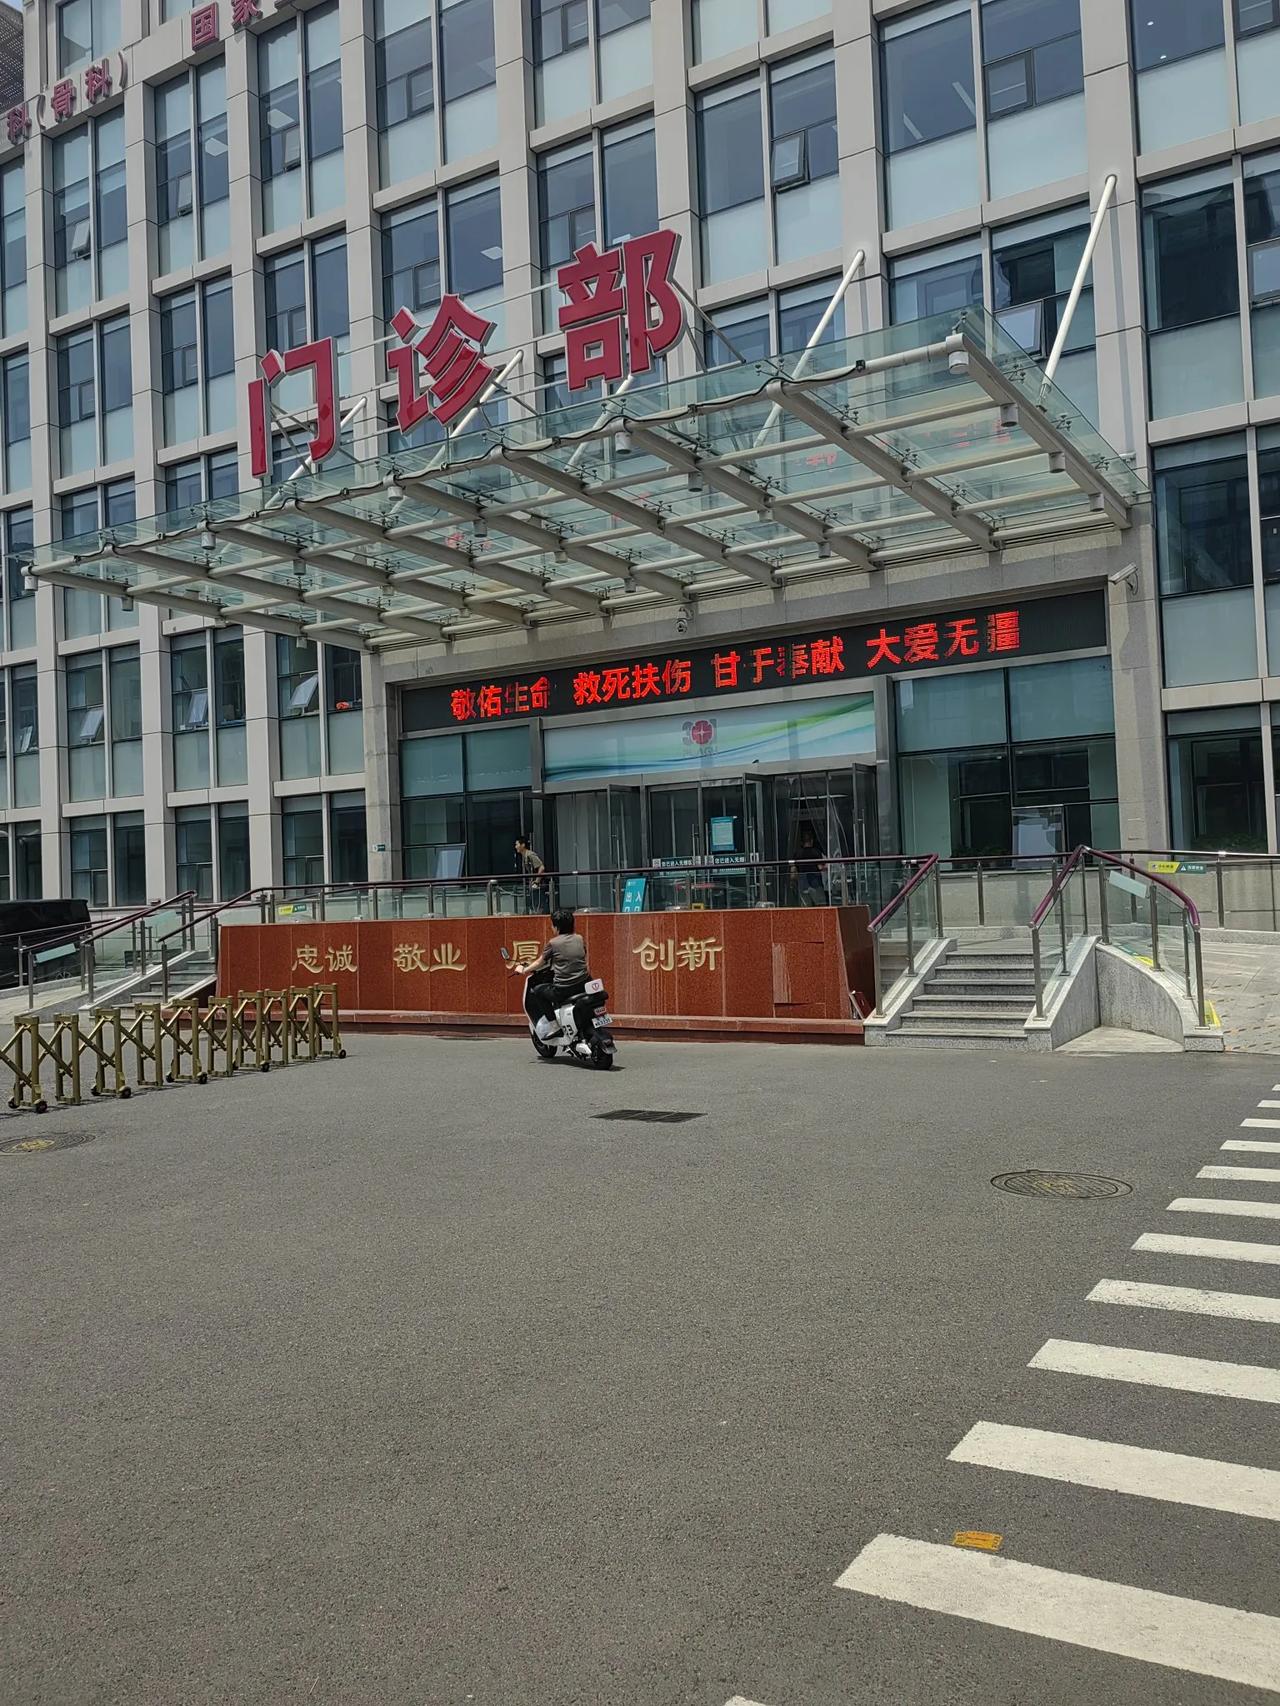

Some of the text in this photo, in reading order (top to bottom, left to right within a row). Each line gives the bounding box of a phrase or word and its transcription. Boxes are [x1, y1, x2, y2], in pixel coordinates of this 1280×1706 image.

[248, 228, 688, 478] 门诊部
[450, 676, 550, 721] 敬佑生命
[572, 659, 692, 706] 救死扶伤
[865, 610, 1020, 670] 大爱无疆
[291, 944, 359, 975] 忠诚
[393, 942, 468, 973] 敬业
[632, 936, 724, 972] 创新
